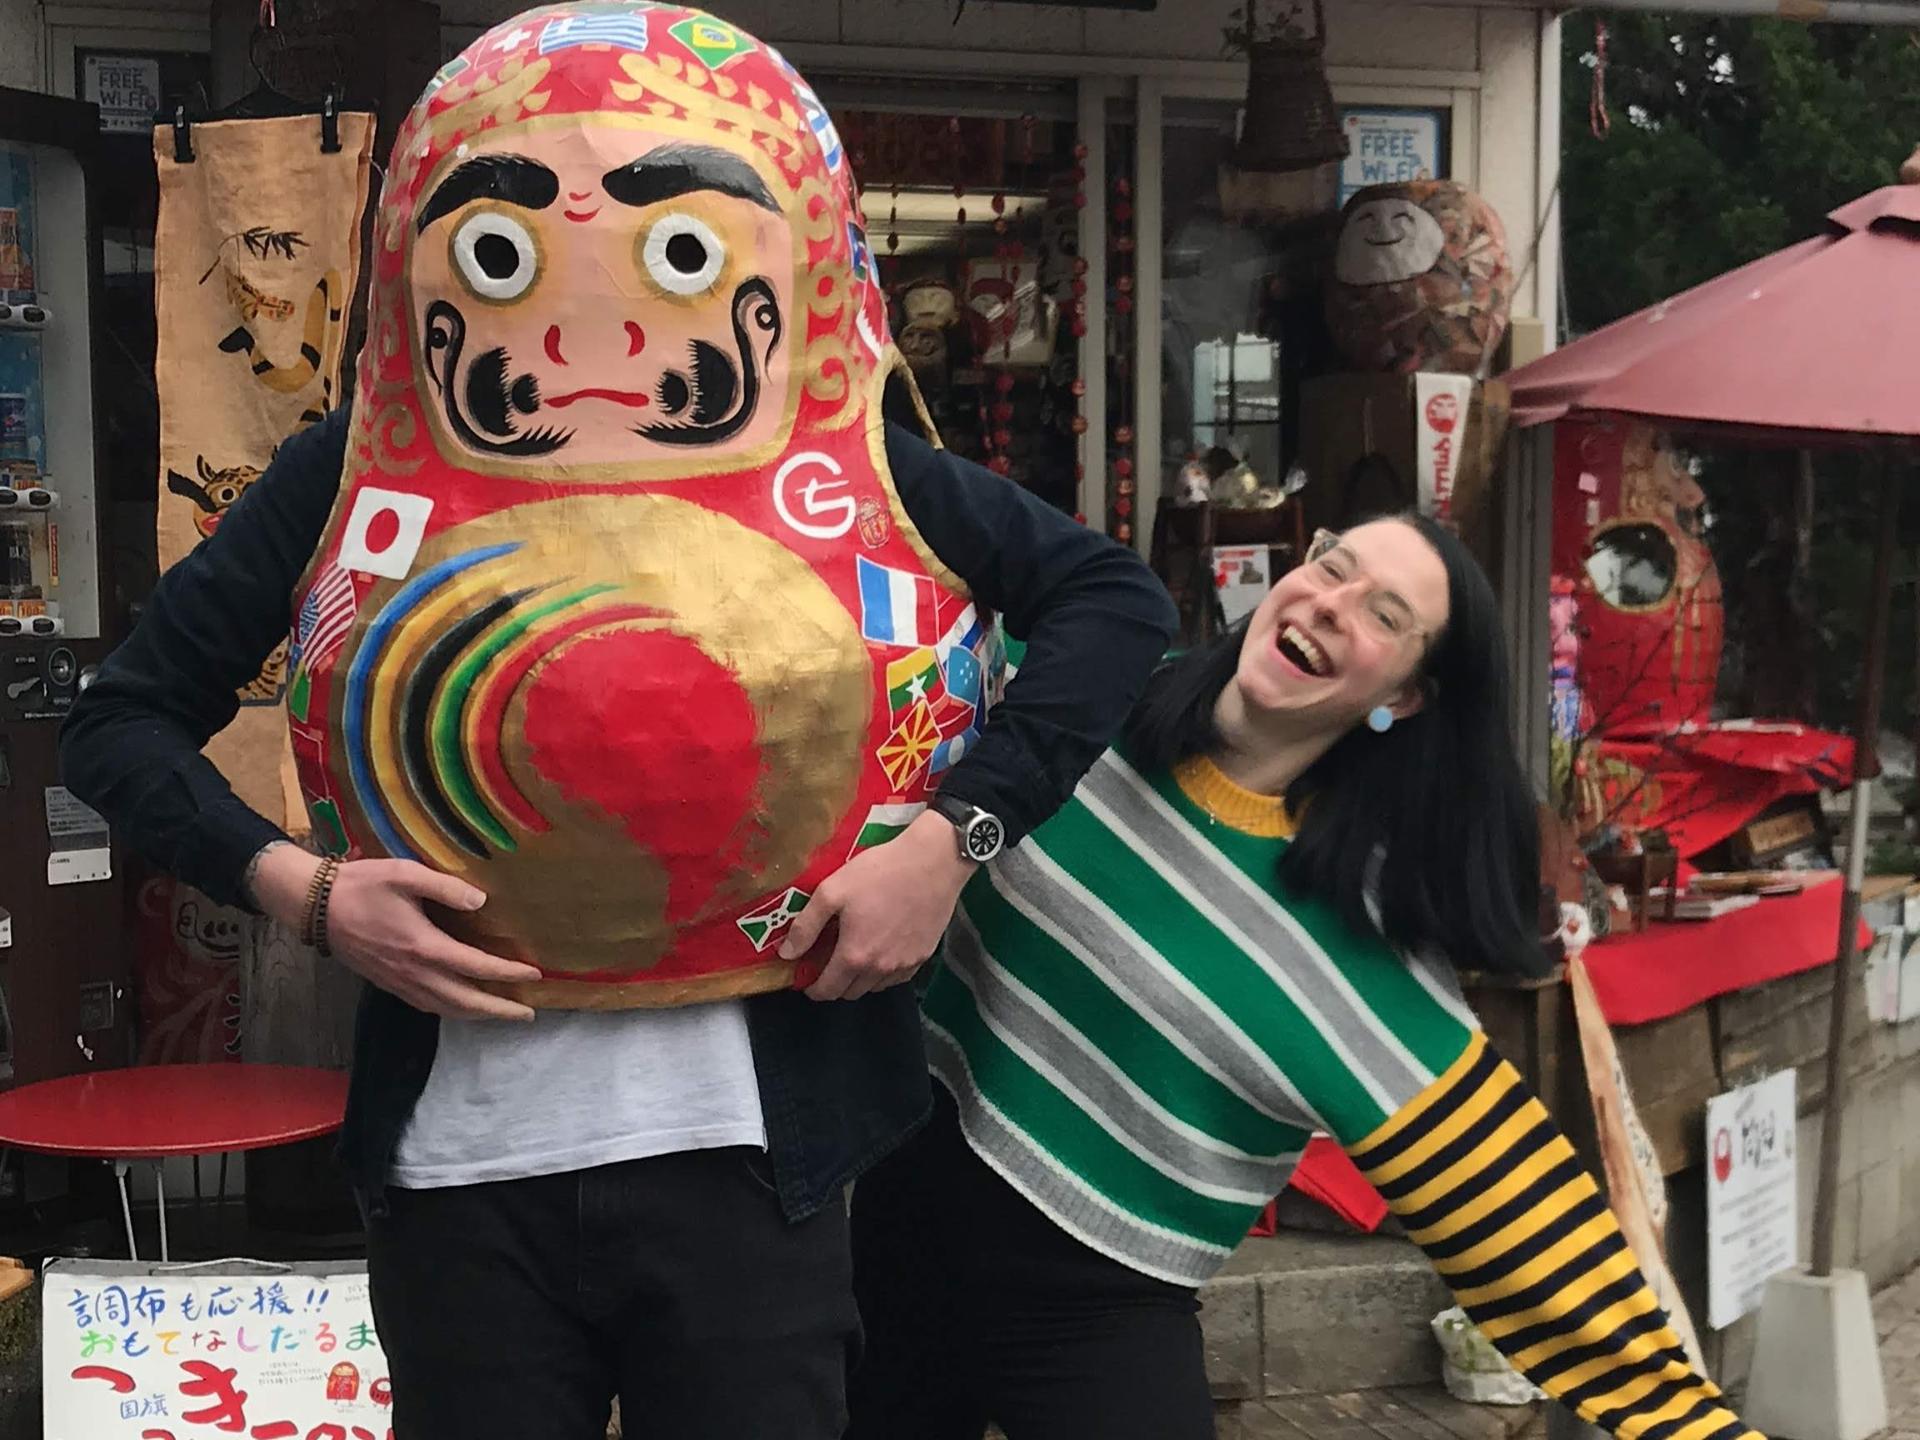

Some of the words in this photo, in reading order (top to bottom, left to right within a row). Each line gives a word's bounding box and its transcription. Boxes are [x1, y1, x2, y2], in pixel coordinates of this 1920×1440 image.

[99, 71, 143, 89] FREE
[1361, 135, 1414, 157] FREE
[79, 1319, 376, 1358] おもてなしだるま
